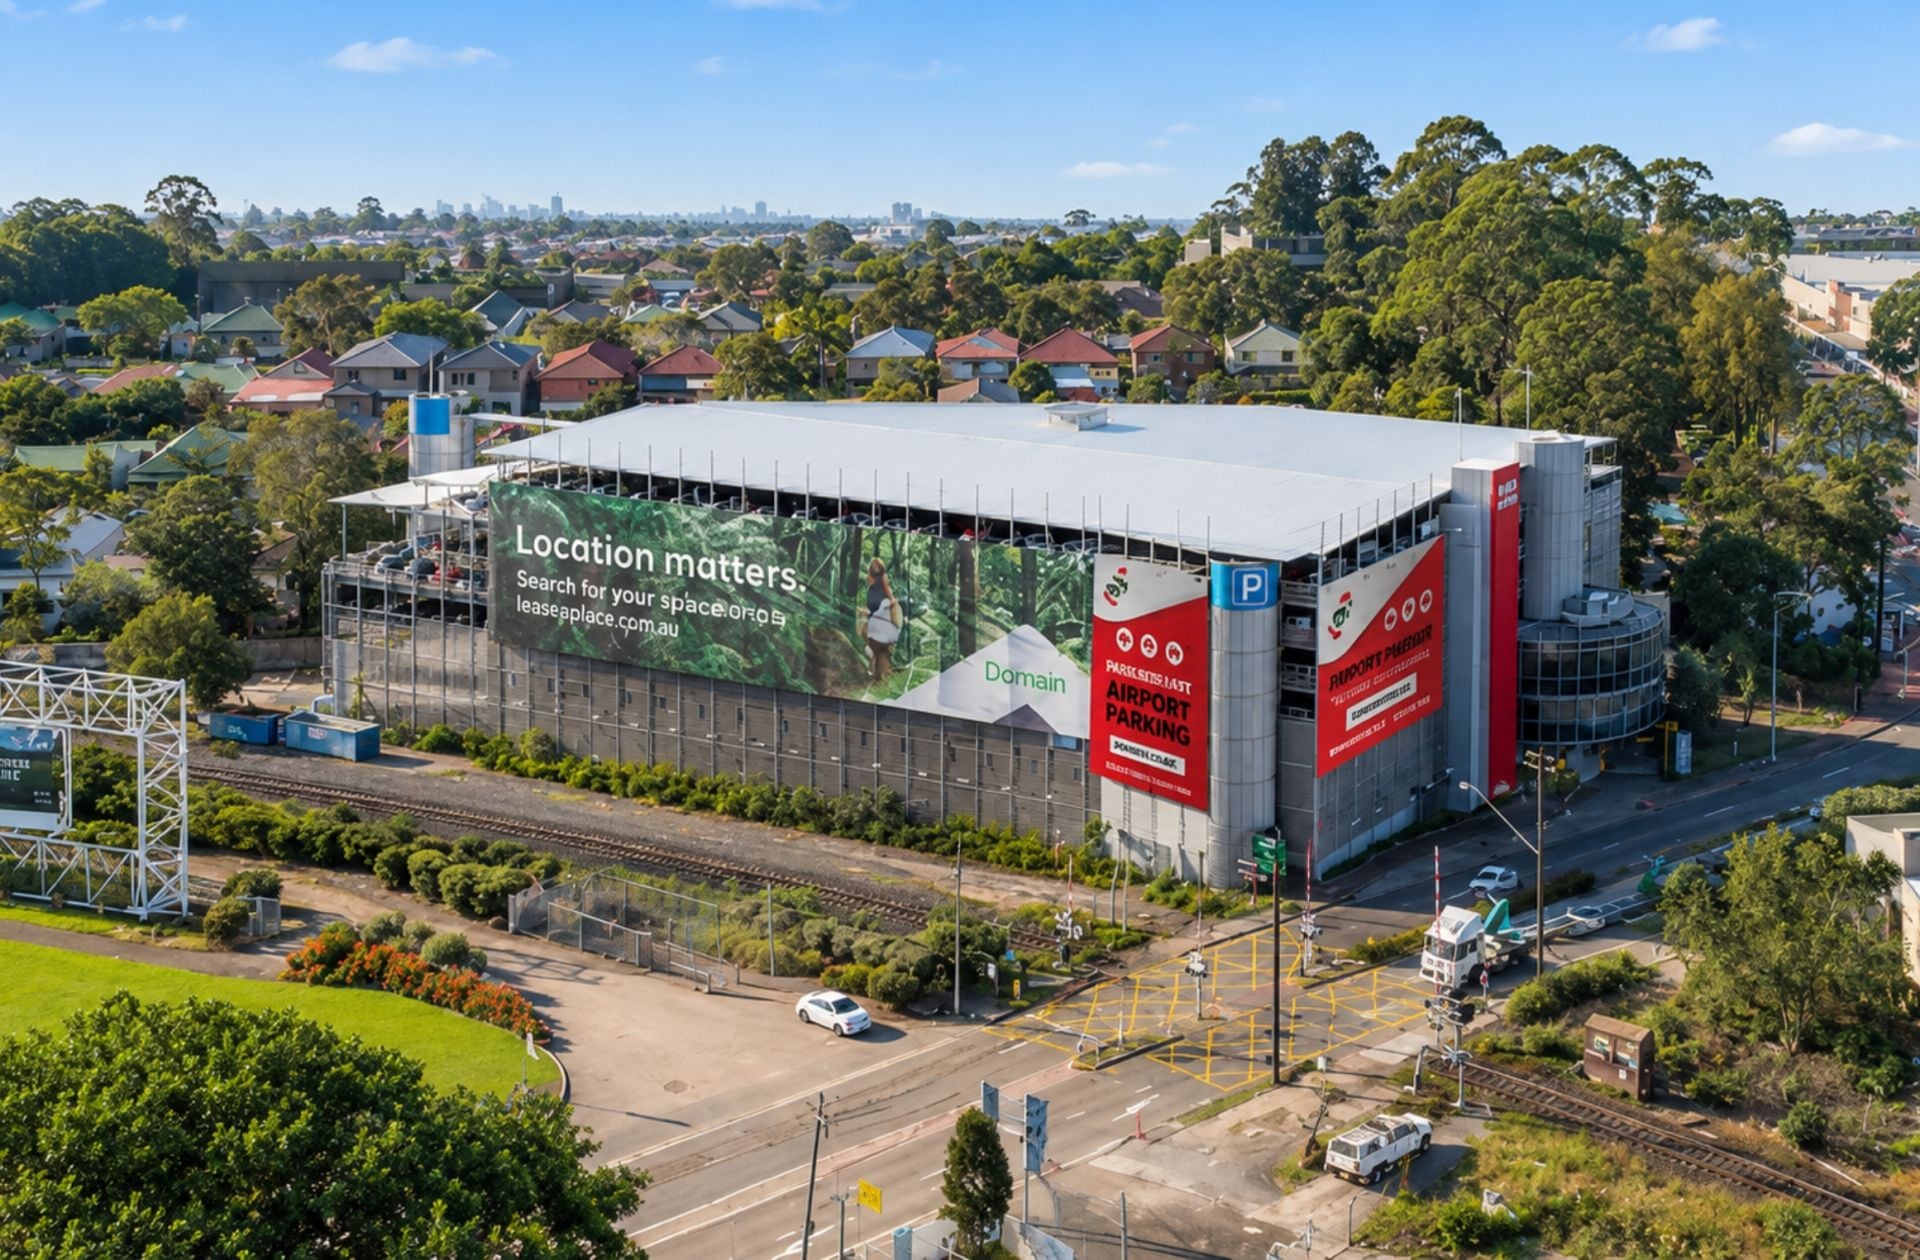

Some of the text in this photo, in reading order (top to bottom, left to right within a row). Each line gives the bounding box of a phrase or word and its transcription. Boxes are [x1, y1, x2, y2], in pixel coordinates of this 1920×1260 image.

[516, 524, 807, 592] Location matters.
[517, 569, 576, 596] Search
[581, 579, 607, 600] for
[611, 587, 656, 607] your
[1242, 573, 1263, 601] P
[985, 660, 1066, 694] Domain
[1106, 679, 1191, 721] AIRPORT
[1105, 701, 1191, 747] PARKING
